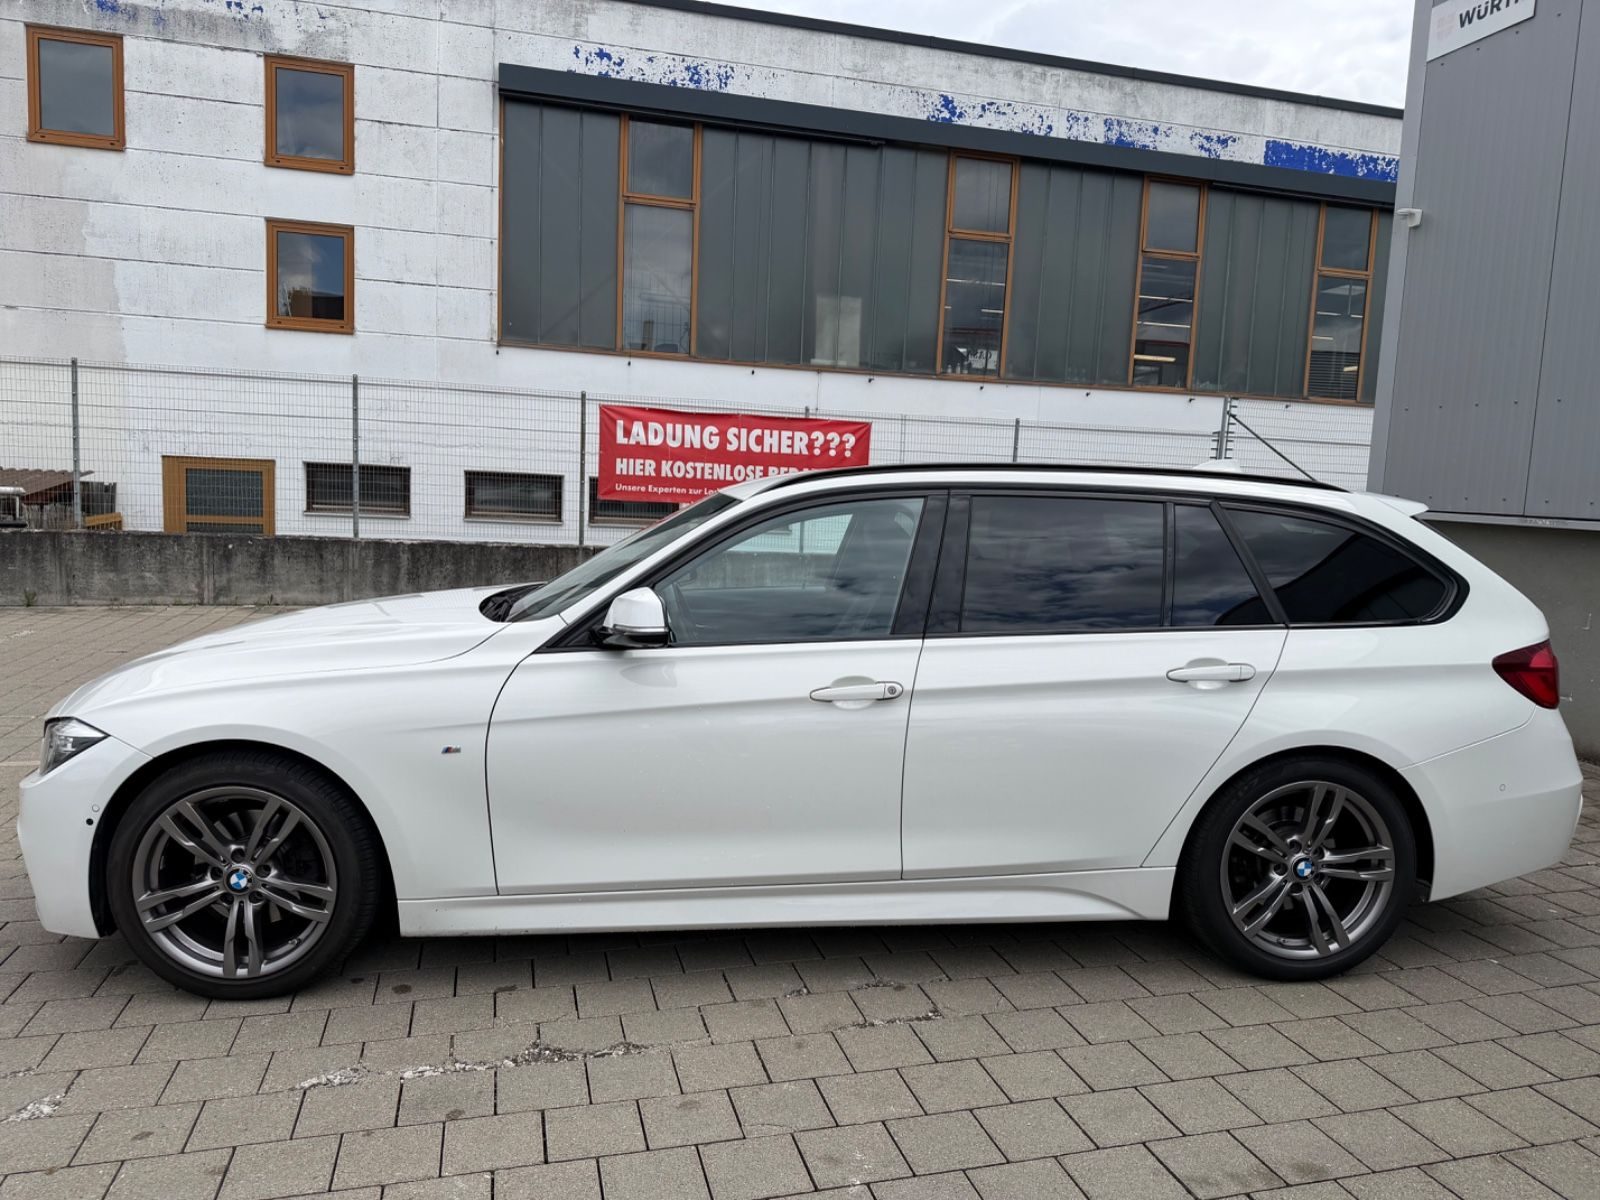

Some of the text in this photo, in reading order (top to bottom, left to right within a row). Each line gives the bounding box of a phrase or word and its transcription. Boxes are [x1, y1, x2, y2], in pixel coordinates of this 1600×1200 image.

[1459, 0, 1519, 29] WÜR
[616, 419, 856, 458] LADUNG SICHER???
[615, 457, 656, 477] HIER
[661, 460, 764, 482] KOSTENLOSE
[615, 483, 646, 492] Unsere
[648, 484, 687, 495] Experten
